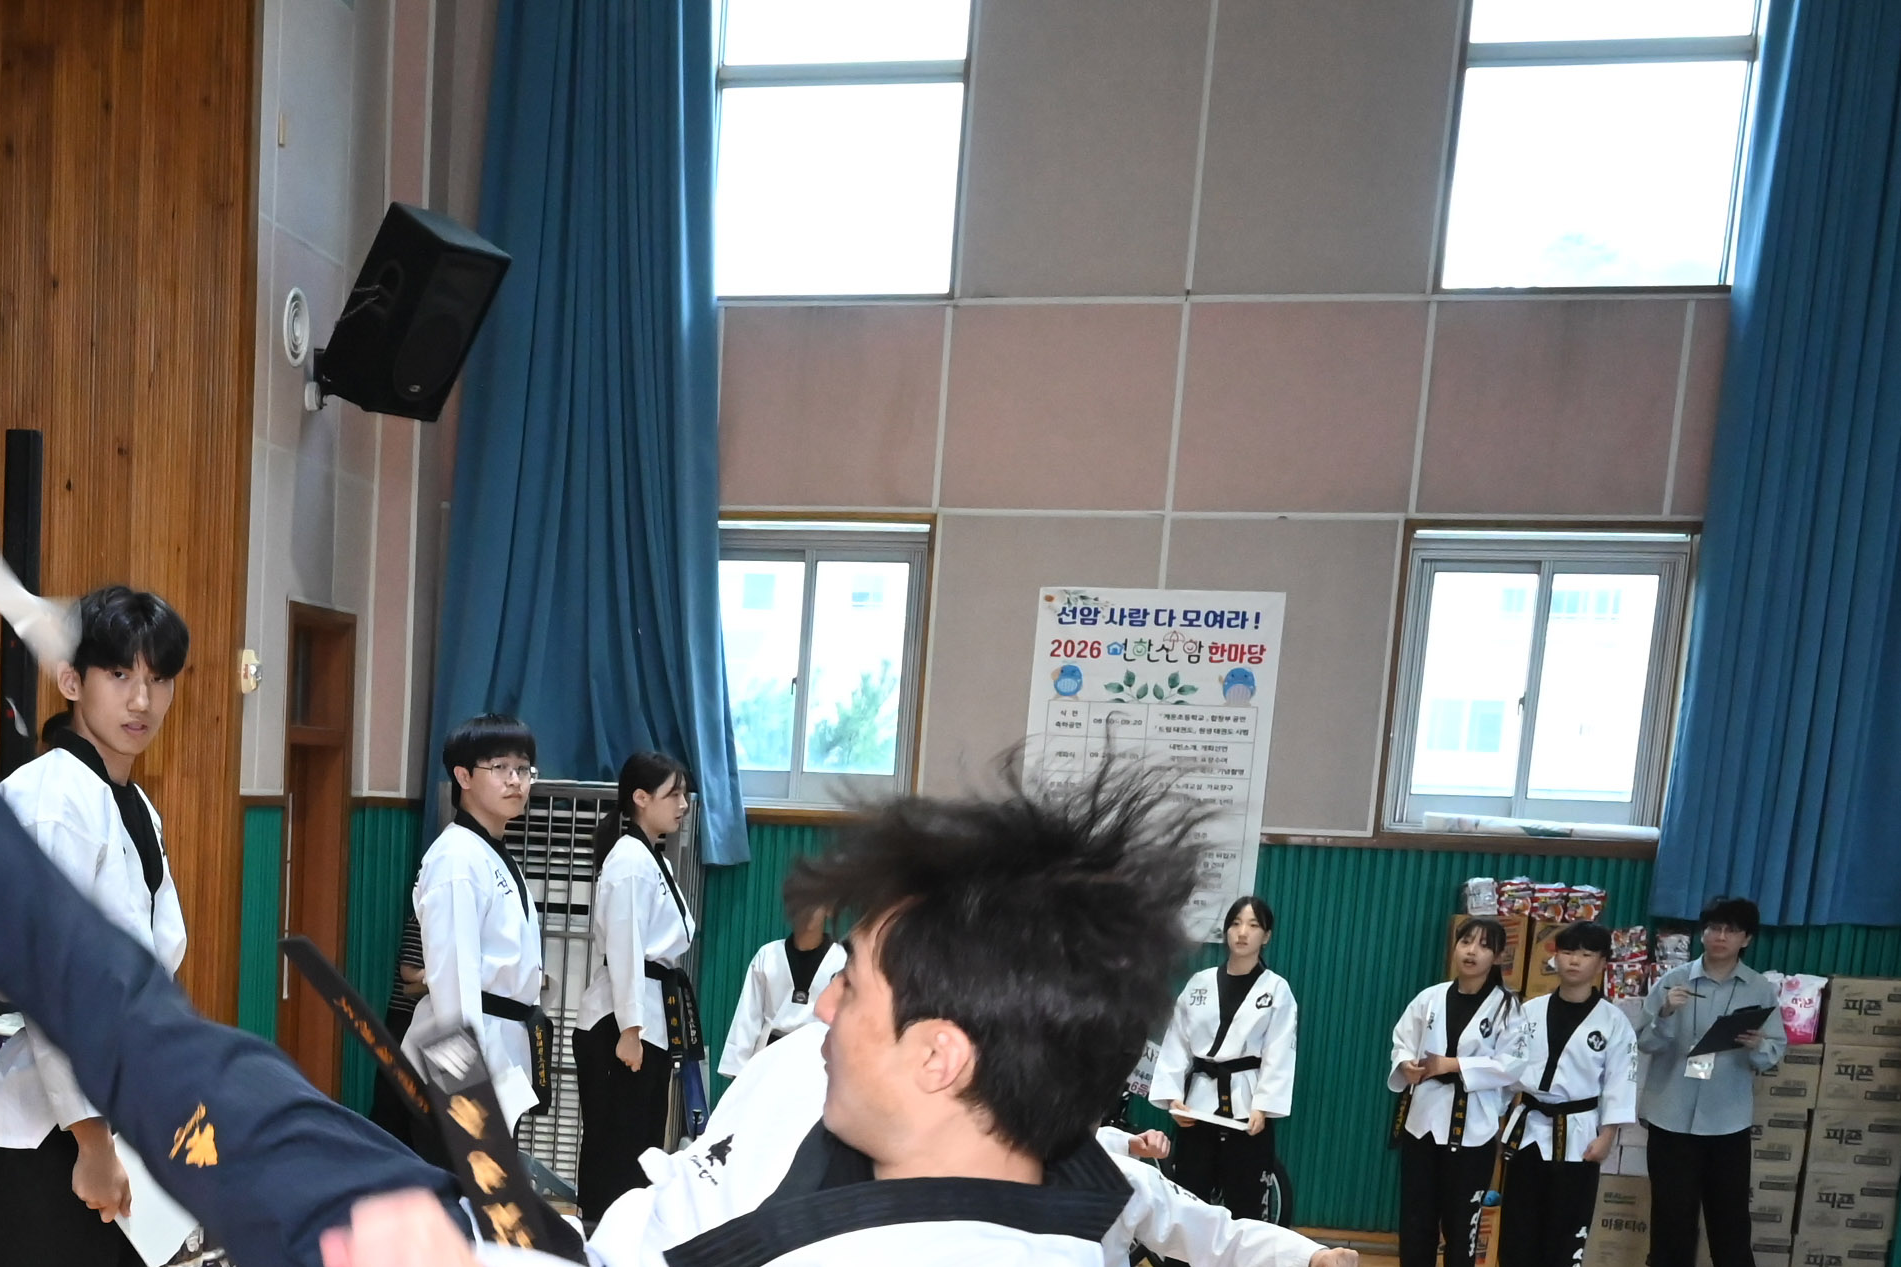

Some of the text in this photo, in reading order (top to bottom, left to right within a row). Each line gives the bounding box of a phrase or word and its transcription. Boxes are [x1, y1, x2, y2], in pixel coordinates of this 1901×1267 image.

[1056, 605, 1101, 626] 선암
[1104, 607, 1149, 628] 사람
[1153, 608, 1176, 629] 다
[1179, 609, 1250, 630] 모여라
[1049, 638, 1102, 660] 2026
[1207, 642, 1267, 665] 한마당
[1842, 998, 1884, 1016] 피죤
[1834, 1063, 1874, 1081] 피죤
[1823, 1127, 1863, 1145] 피죤
[1814, 1191, 1856, 1209] 피죤
